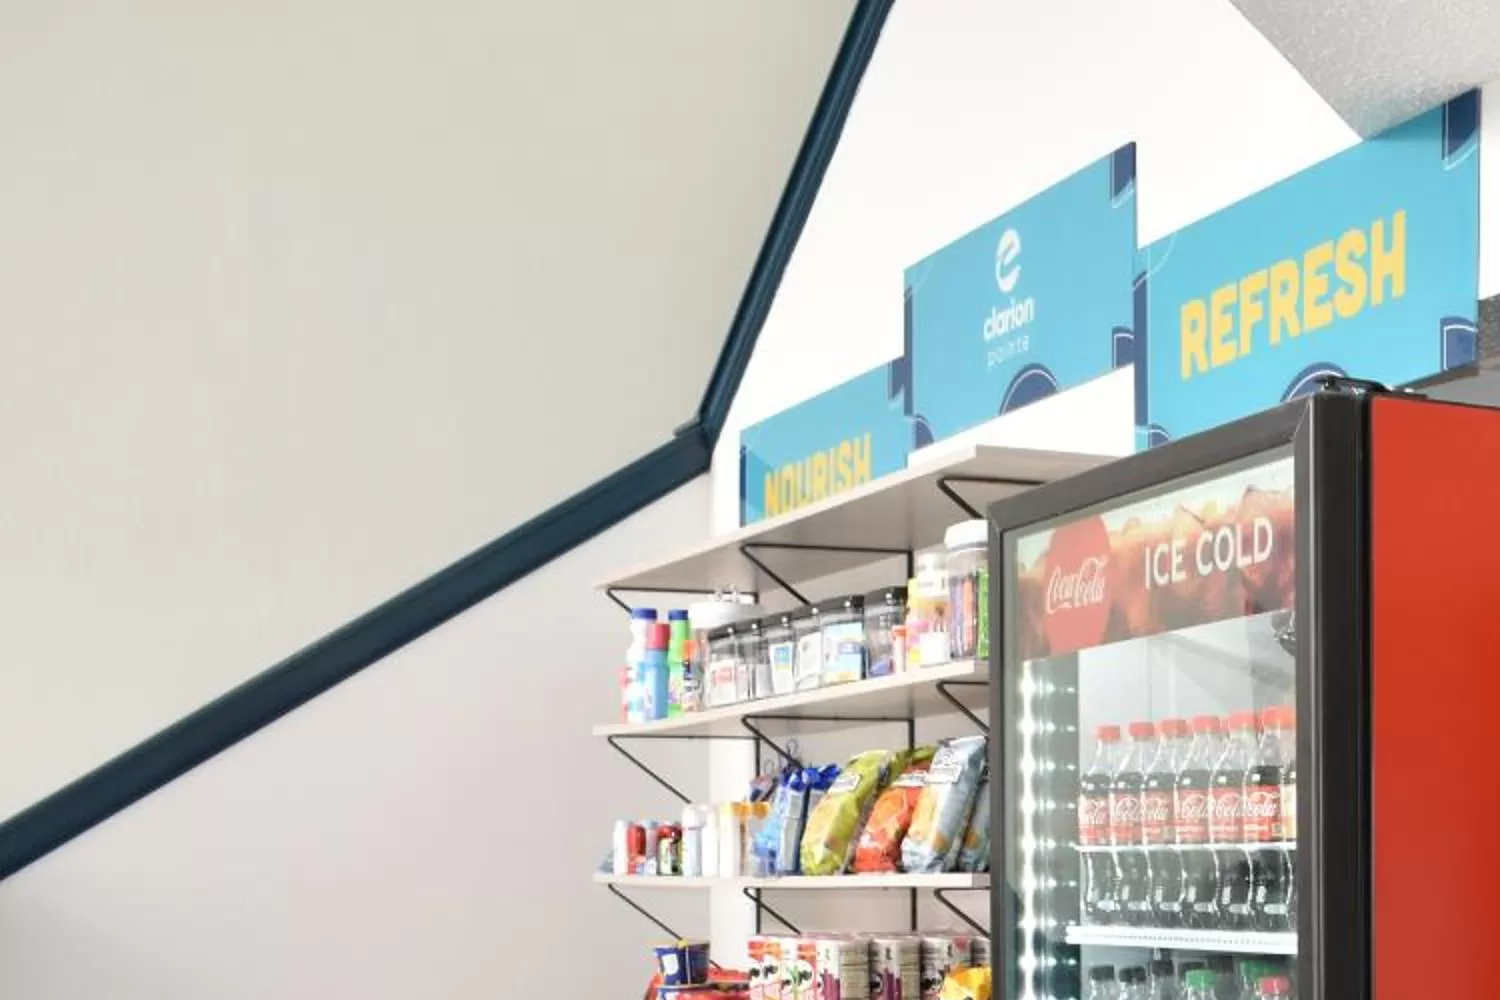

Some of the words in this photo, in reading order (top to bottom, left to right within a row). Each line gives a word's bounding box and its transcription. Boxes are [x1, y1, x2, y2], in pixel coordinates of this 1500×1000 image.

[982, 298, 1034, 341] clarion
[1179, 209, 1407, 381] REFRESH
[763, 432, 873, 518] NOURISH
[1045, 555, 1109, 615] Coca-Cola
[1144, 541, 1188, 590] ICE
[1194, 515, 1275, 578] COLD
